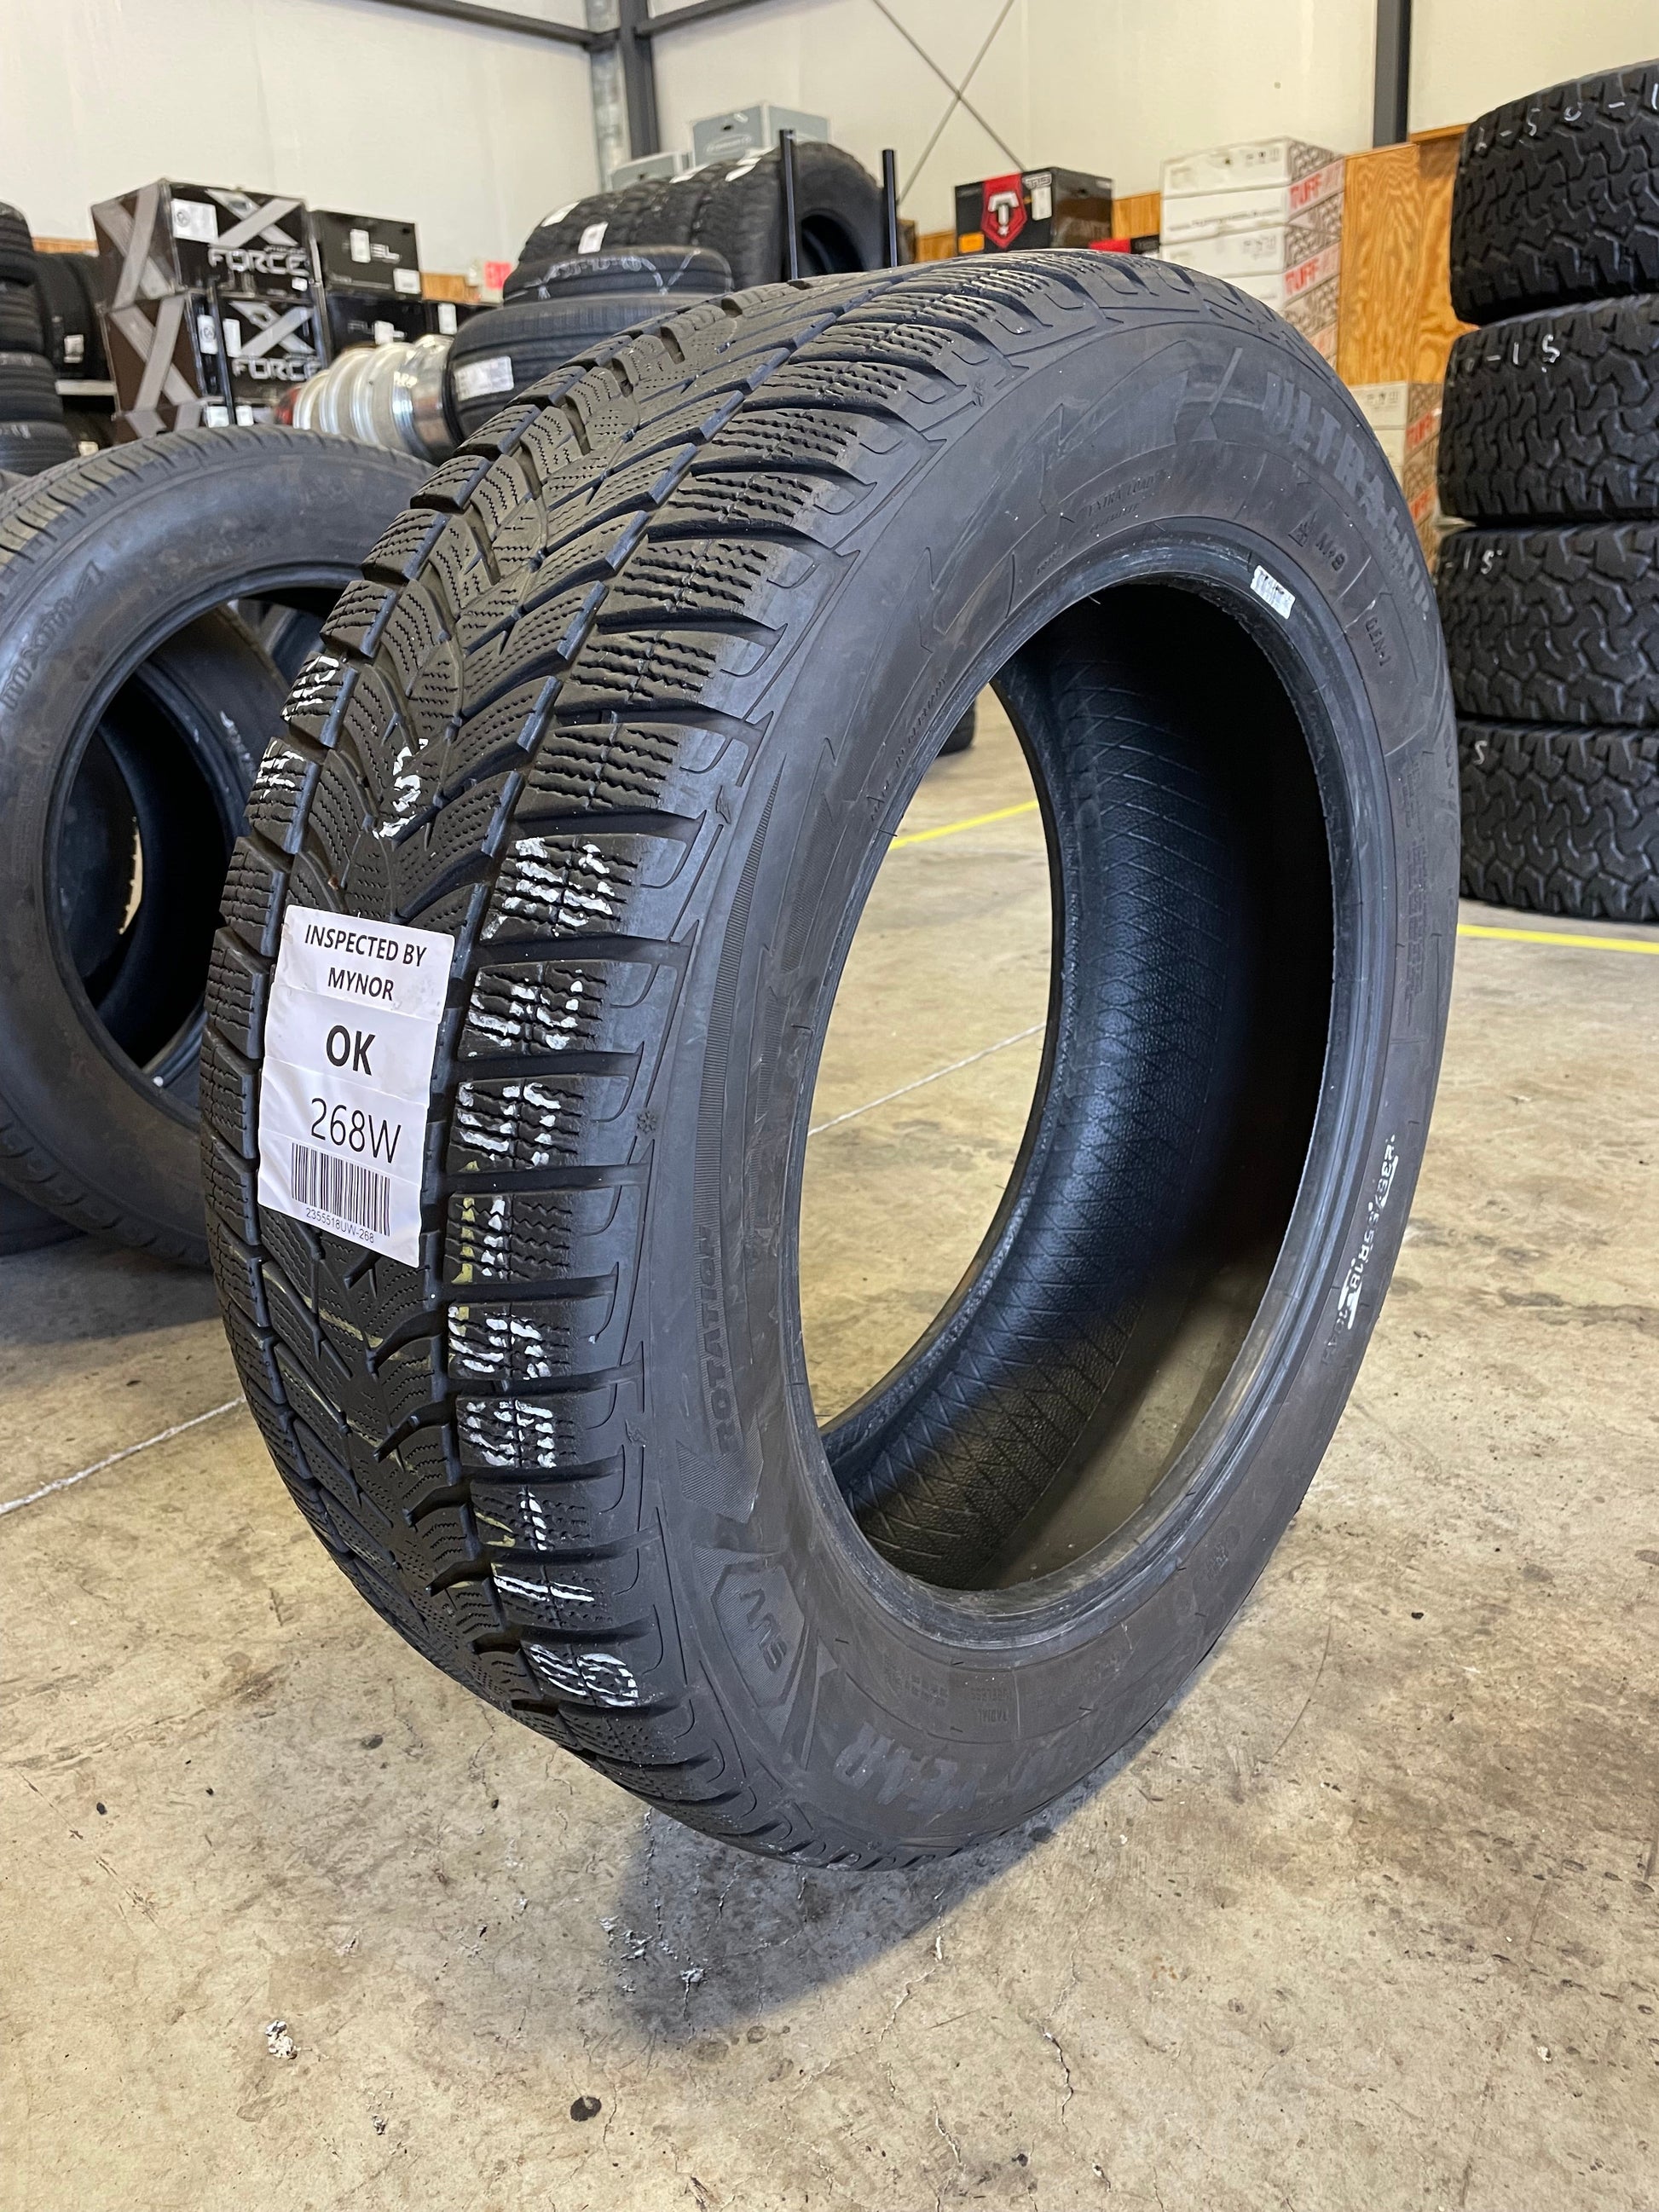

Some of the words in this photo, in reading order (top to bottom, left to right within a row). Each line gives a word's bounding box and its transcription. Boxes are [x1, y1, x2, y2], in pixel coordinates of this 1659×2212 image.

[208, 248, 310, 277] FORCE
[304, 923, 398, 962] INSPECTED
[402, 943, 427, 967] BY
[327, 967, 394, 1002] MYNOR
[326, 1024, 376, 1076] OK
[310, 1096, 402, 1164] 268W
[305, 1206, 375, 1244] 2355518UW-268
[698, 1224, 739, 1454] ROTATION
